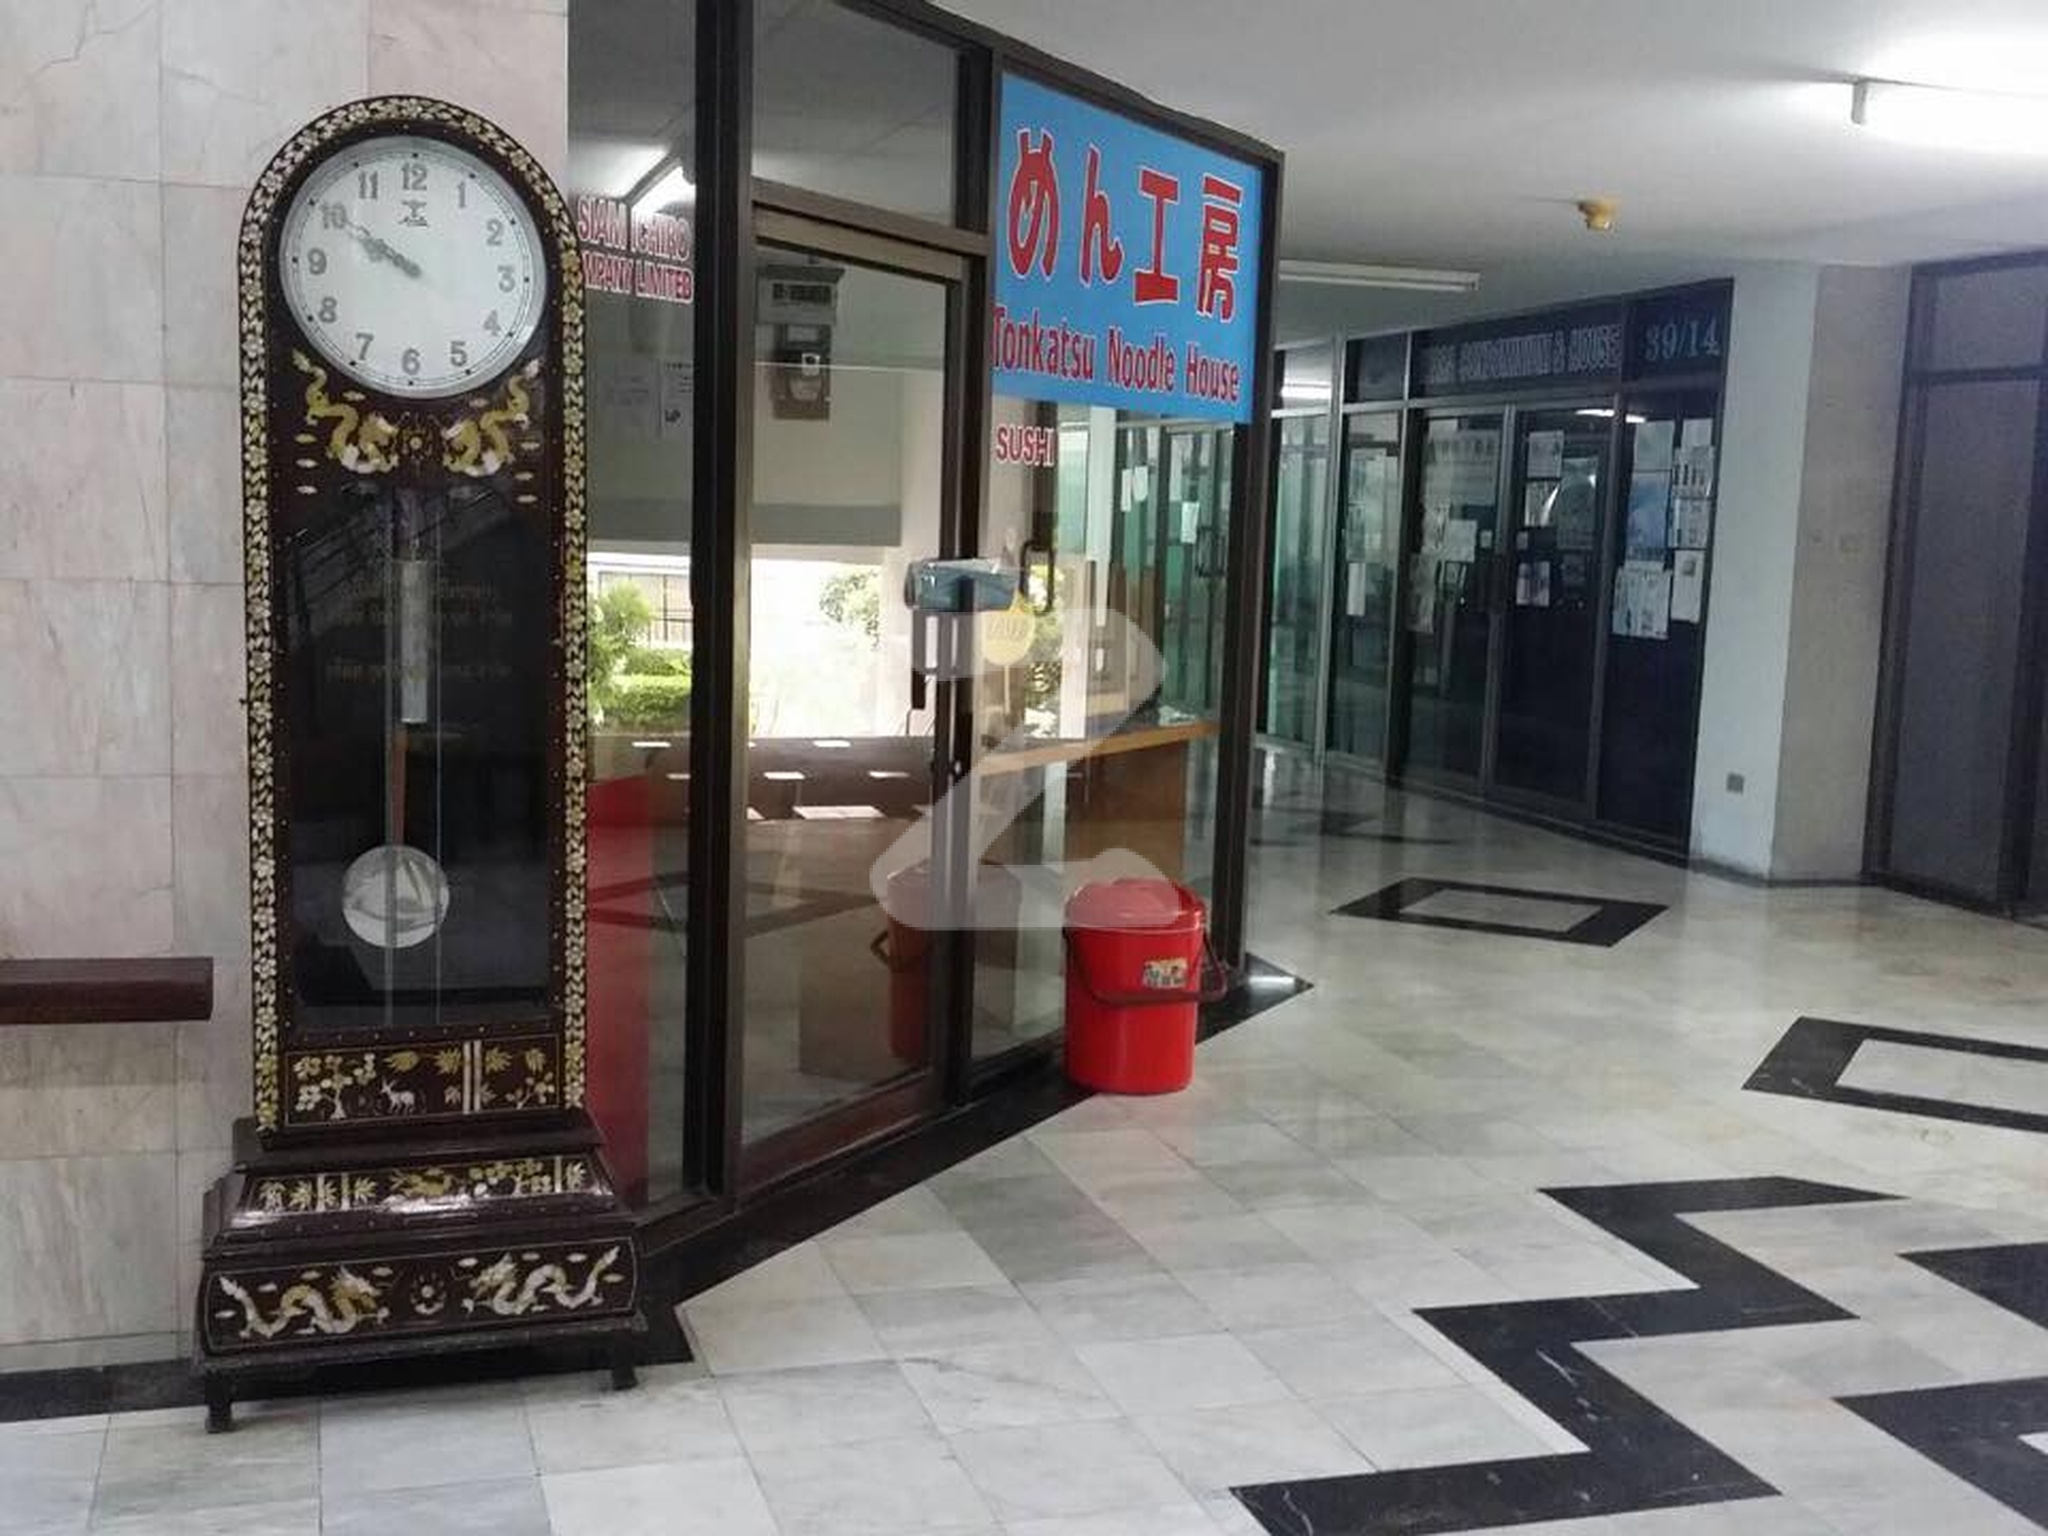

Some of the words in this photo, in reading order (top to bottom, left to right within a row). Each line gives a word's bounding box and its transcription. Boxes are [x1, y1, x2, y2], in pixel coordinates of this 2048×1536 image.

[358, 171, 379, 200] 11
[401, 163, 428, 191] 12
[457, 181, 467, 208] 1
[320, 202, 347, 230] 10
[578, 194, 628, 250] SIAM
[1007, 128, 1243, 323] めん工房
[486, 219, 503, 246] 2
[307, 249, 327, 275] 9
[498, 265, 515, 293] 3
[635, 258, 694, 304] LIMITED
[319, 297, 337, 324] 8
[483, 310, 500, 337] 4
[355, 333, 373, 361] 7
[450, 341, 467, 367] 5
[989, 304, 1095, 382] Tonkatsu
[1106, 325, 1174, 392] Noodle
[1185, 340, 1240, 402] House
[402, 348, 420, 375] 6
[995, 424, 1057, 467] SUSHI
